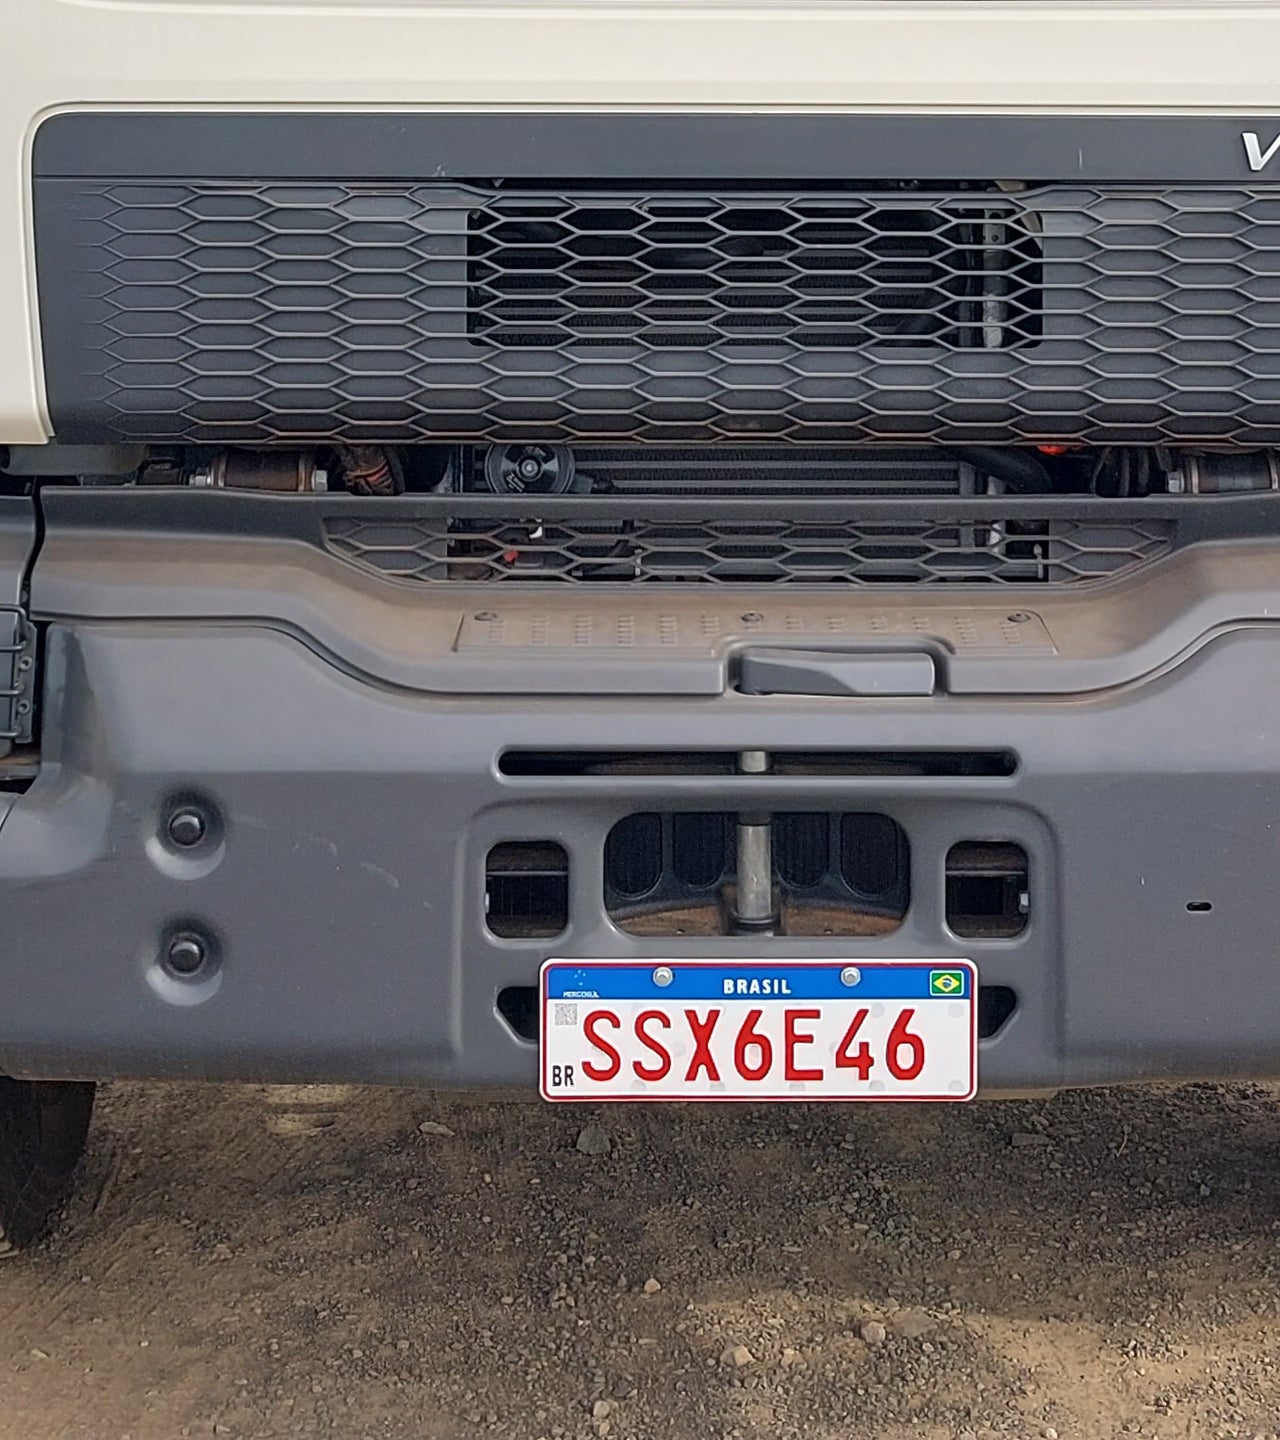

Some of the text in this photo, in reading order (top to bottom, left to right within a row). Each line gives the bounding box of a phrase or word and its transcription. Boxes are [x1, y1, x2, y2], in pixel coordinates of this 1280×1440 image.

[723, 978, 792, 995] BRASIL
[552, 1008, 926, 1087] BR SSX6E46
